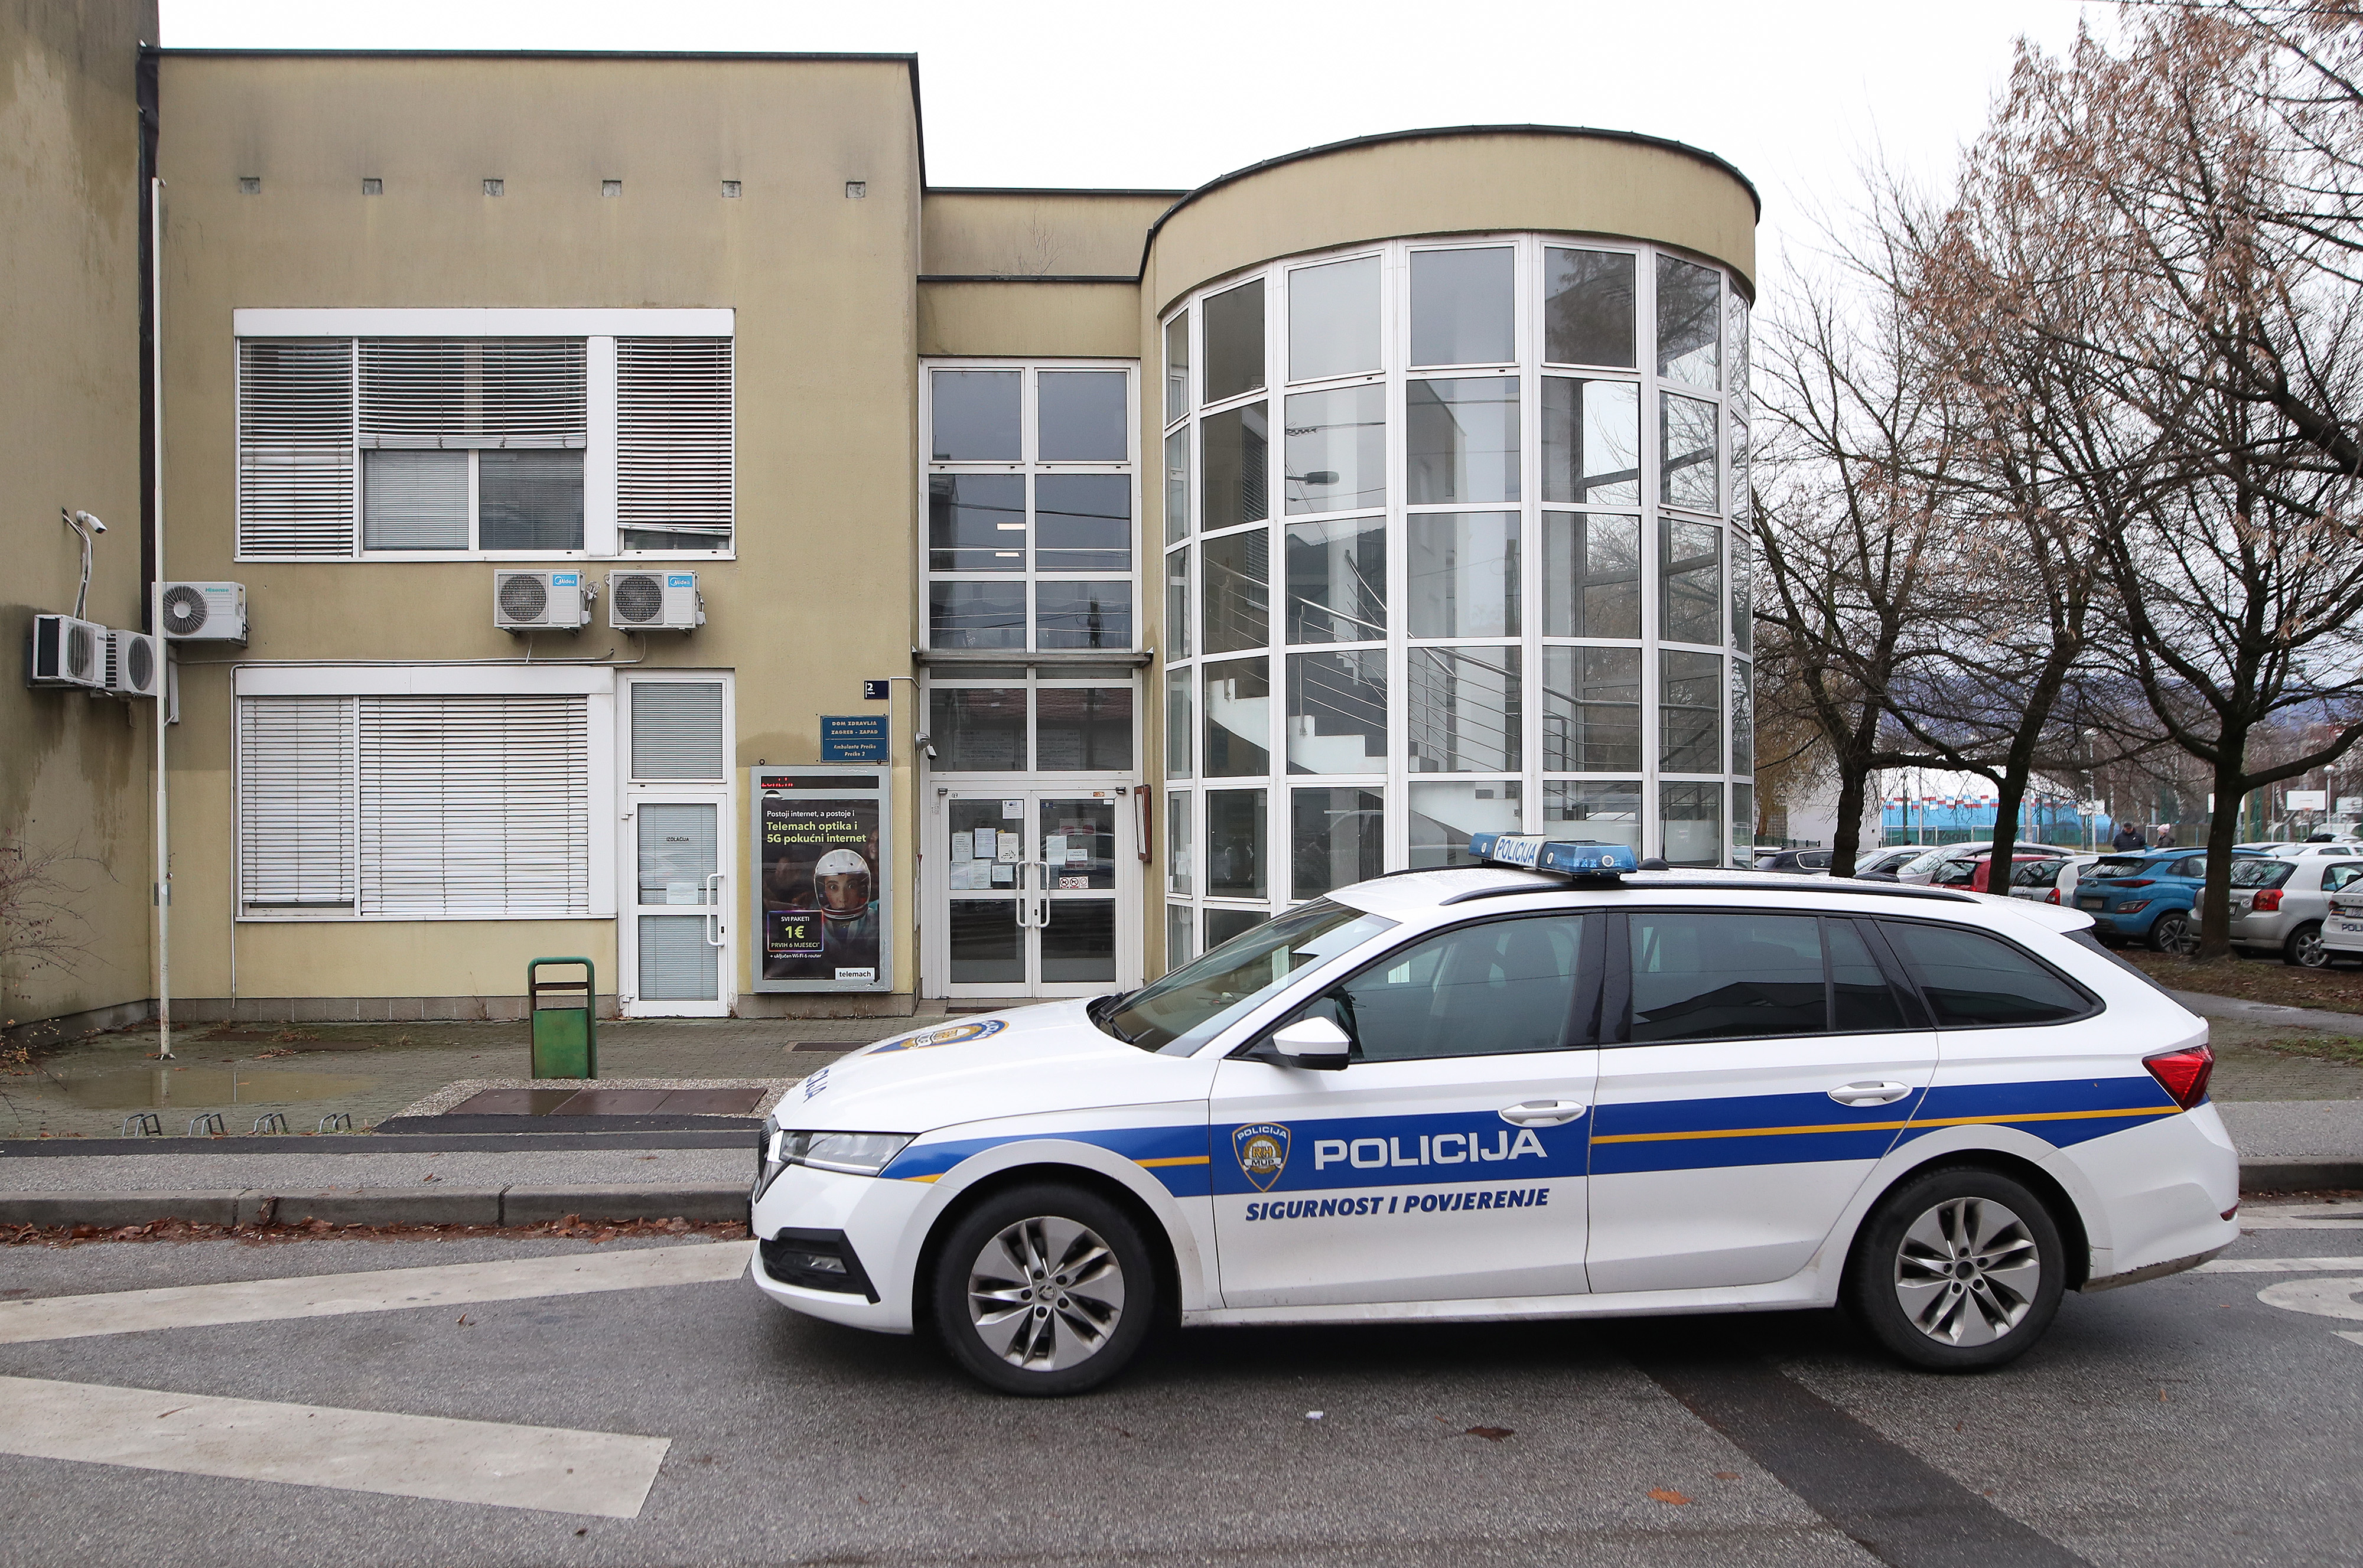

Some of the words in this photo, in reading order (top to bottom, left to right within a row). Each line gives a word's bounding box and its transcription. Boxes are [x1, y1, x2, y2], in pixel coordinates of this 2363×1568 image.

[555, 576, 575, 585] Midea
[670, 577, 691, 586] Midea
[867, 683, 873, 691] 2
[767, 810, 789, 819] Postoji
[826, 810, 851, 819] postoje
[766, 821, 816, 830] Telemach
[818, 821, 852, 833] optika
[854, 821, 857, 830] i
[767, 834, 782, 843] 5G
[784, 833, 824, 845] pokućni
[826, 833, 867, 842] internet
[1496, 839, 1538, 863] POLICIJA
[785, 925, 805, 938] 1€
[1237, 1126, 1287, 1141] POLICIJA
[1252, 1146, 1273, 1158] RH
[1314, 1129, 1548, 1170] POLICIJA
[1245, 1197, 1385, 1221] SIGURNOST
[1388, 1196, 1399, 1214] I
[1404, 1188, 1550, 1214] POVJERENJE
